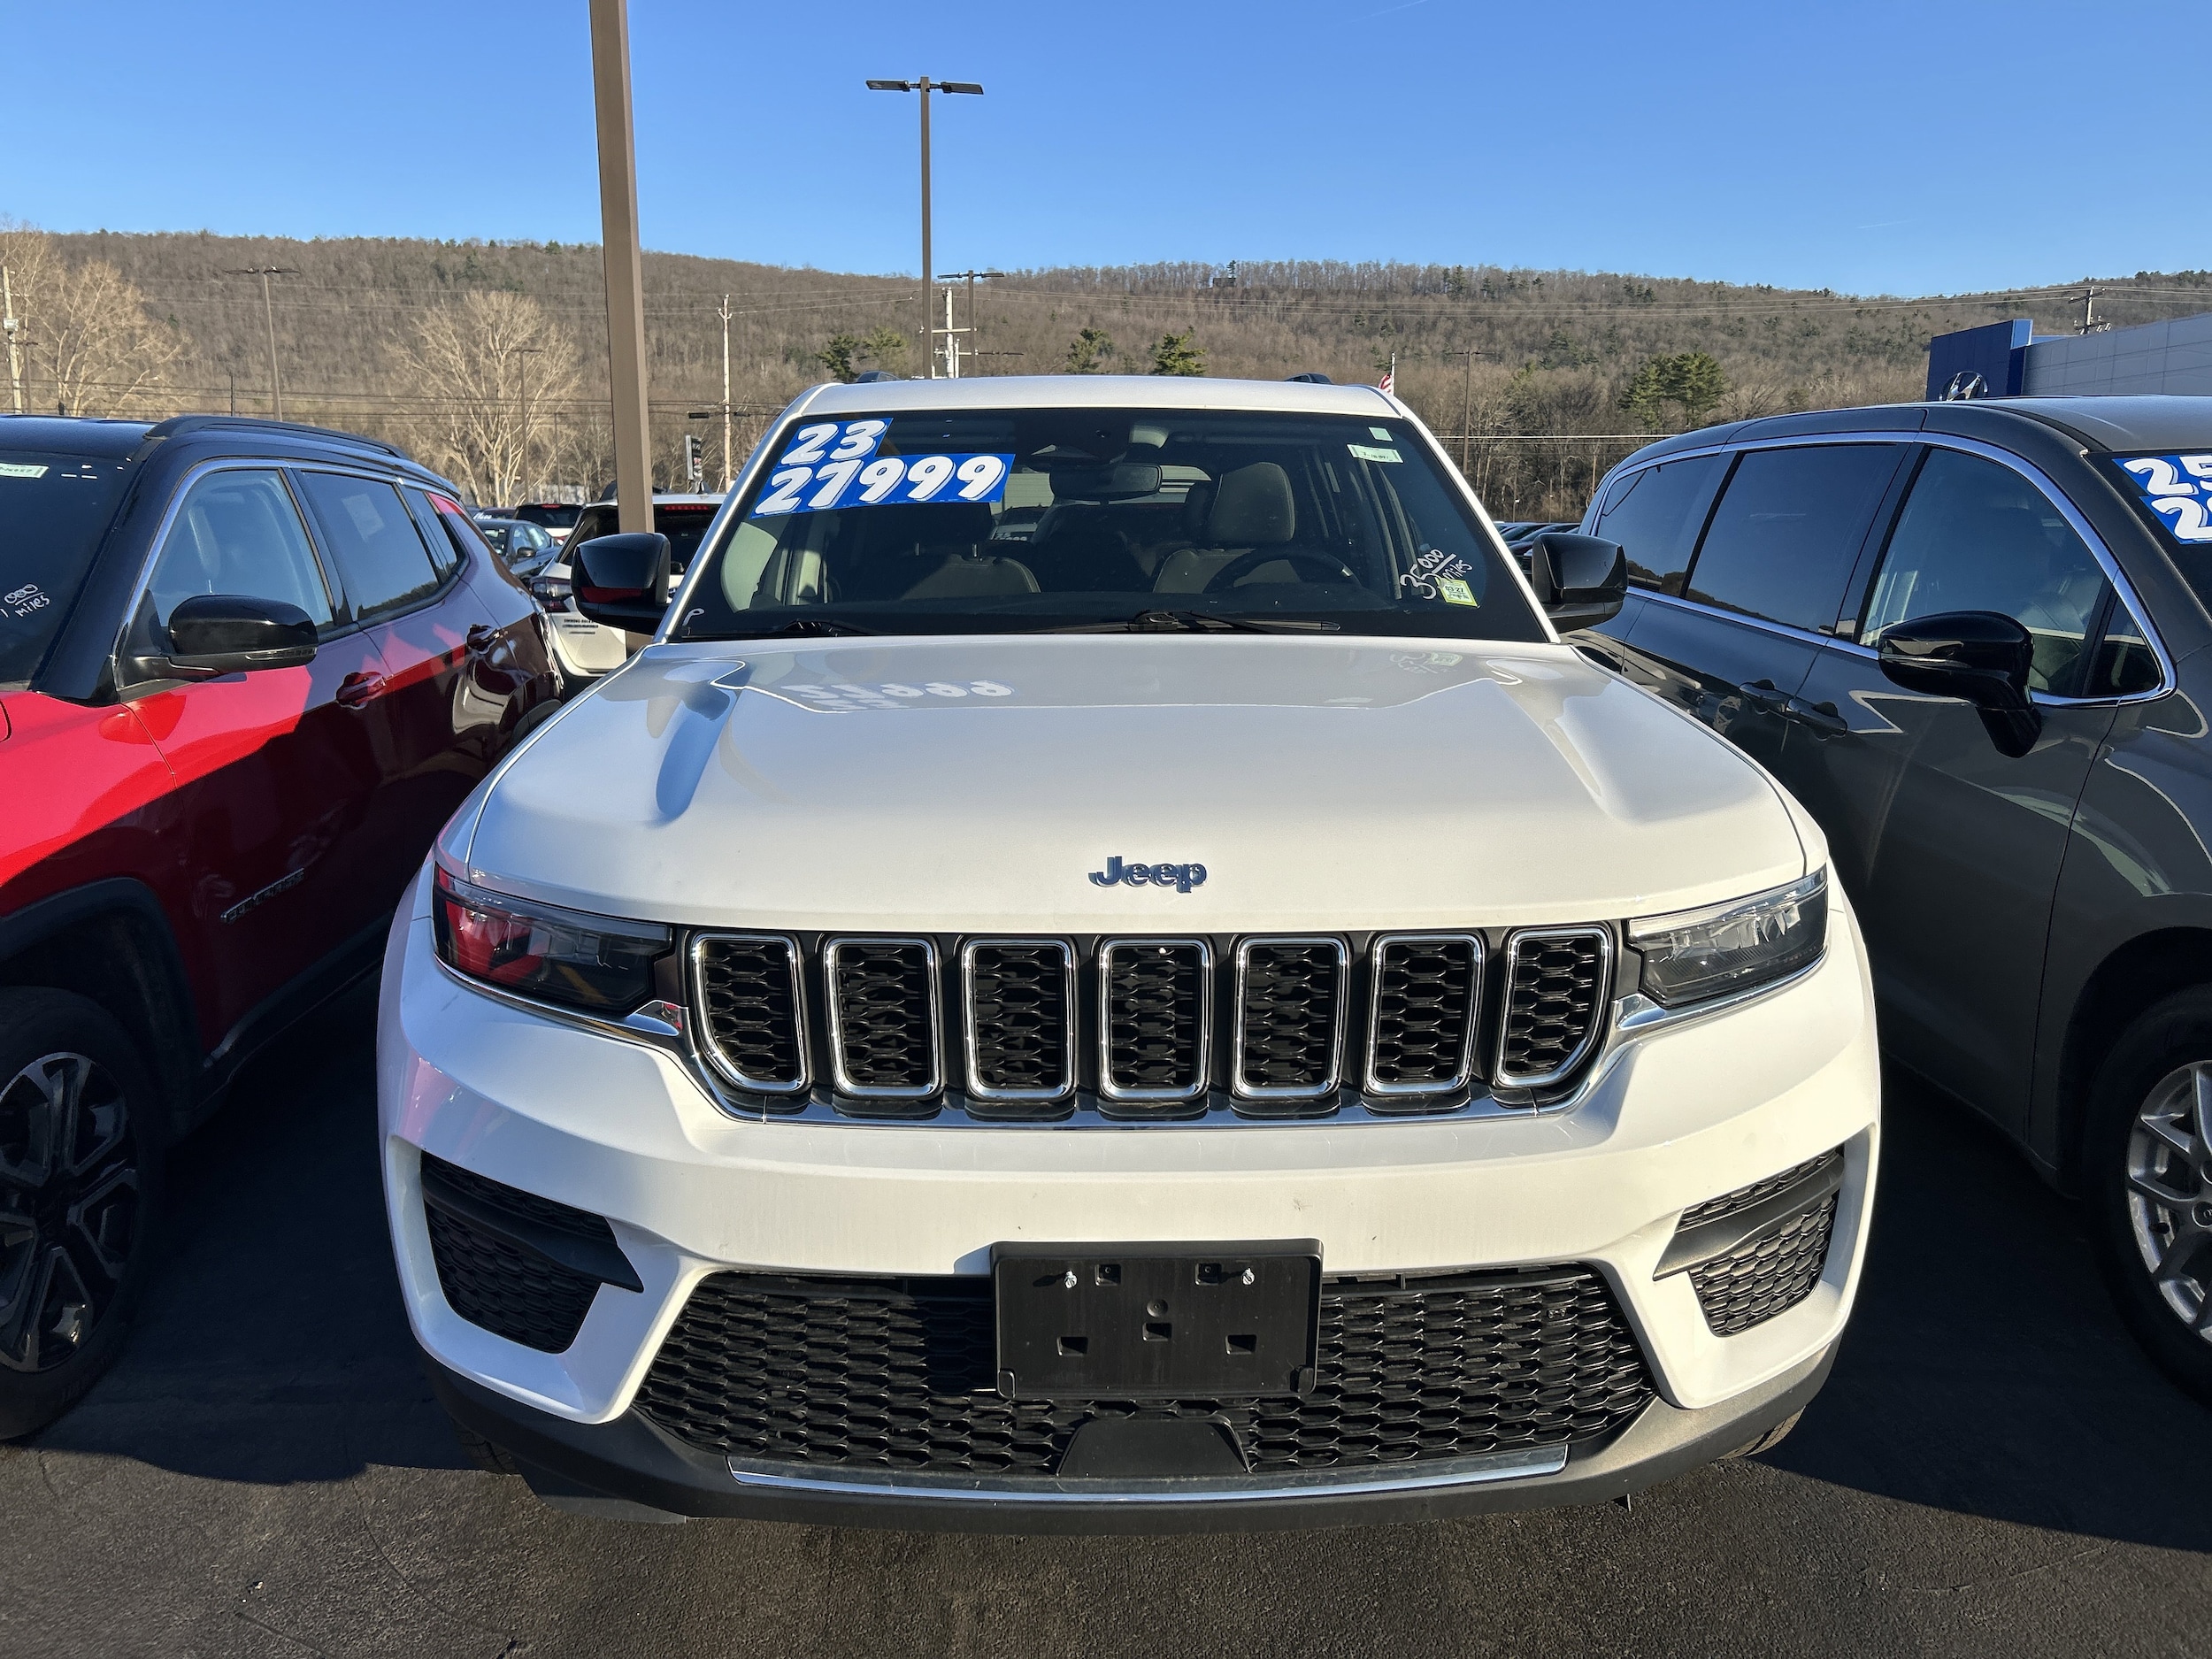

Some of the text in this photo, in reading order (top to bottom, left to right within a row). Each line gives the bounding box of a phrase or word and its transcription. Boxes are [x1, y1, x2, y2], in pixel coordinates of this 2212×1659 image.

[781, 420, 887, 465] 23
[755, 456, 1006, 516] 27999
[2151, 496, 2212, 541] 2
[1089, 856, 1207, 893] Jeep
